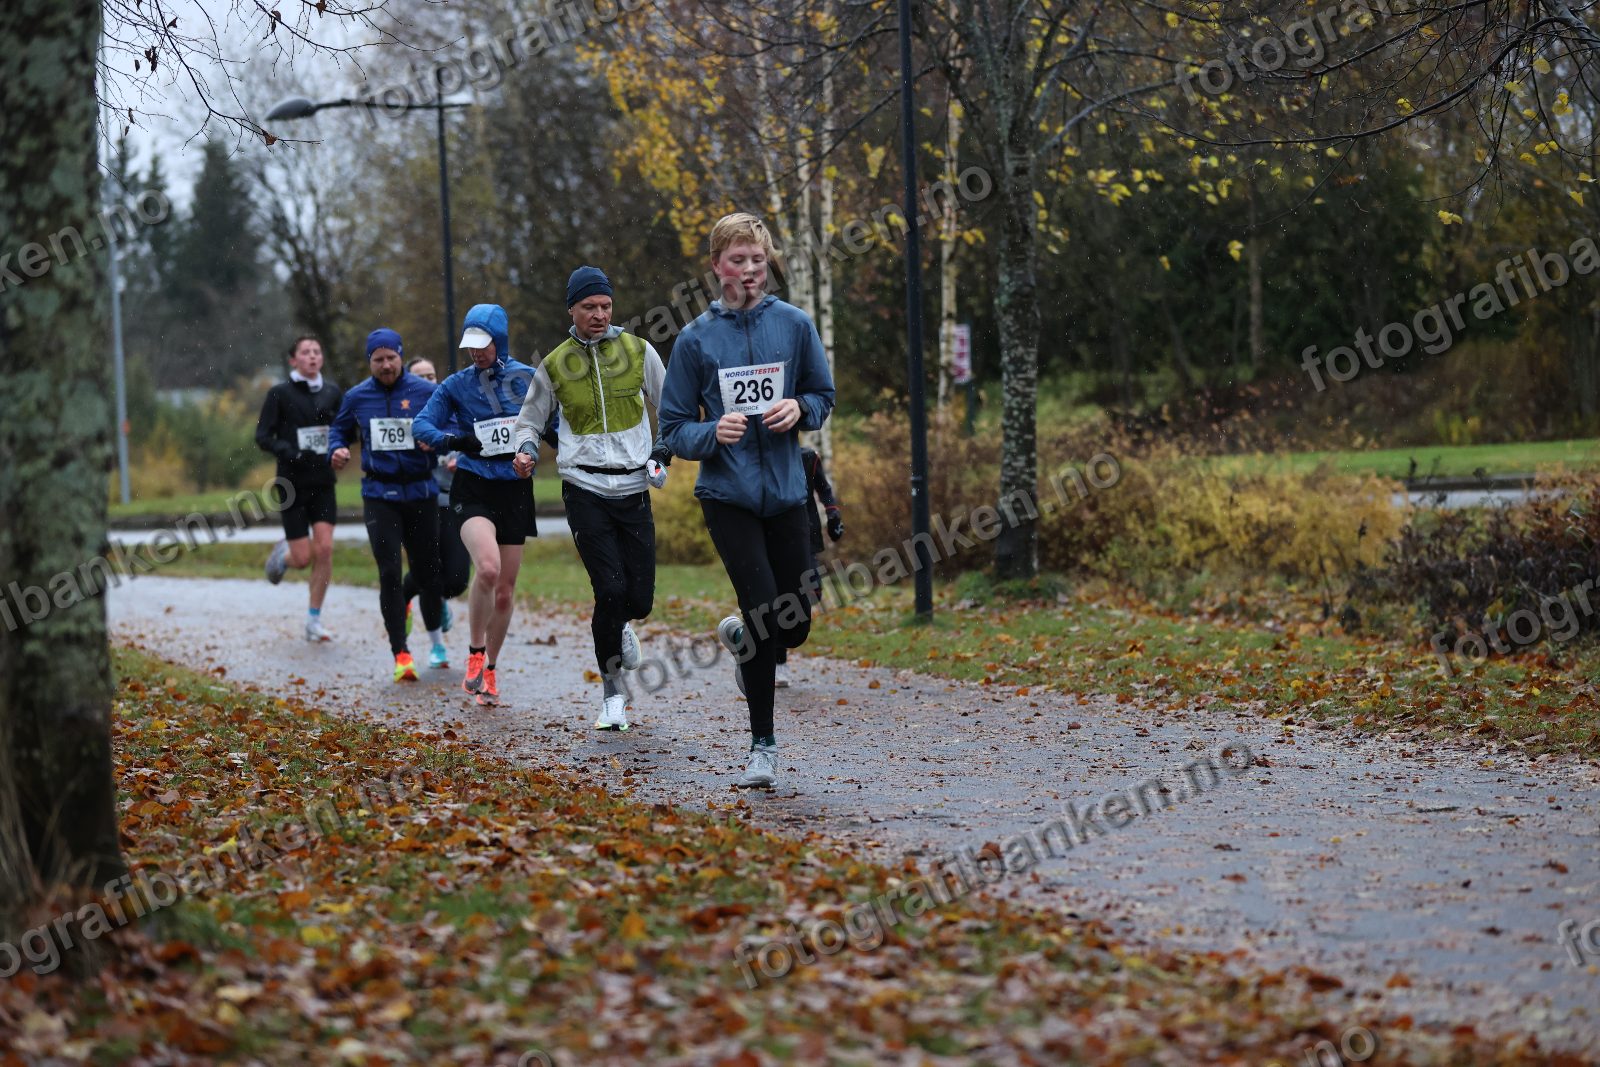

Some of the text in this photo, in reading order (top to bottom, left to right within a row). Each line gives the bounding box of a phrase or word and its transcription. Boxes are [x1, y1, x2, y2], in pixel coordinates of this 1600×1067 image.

[724, 366, 780, 379] NORGESTESTEN
[733, 377, 774, 405] 236
[379, 427, 405, 443] 769
[491, 427, 510, 445] 49
